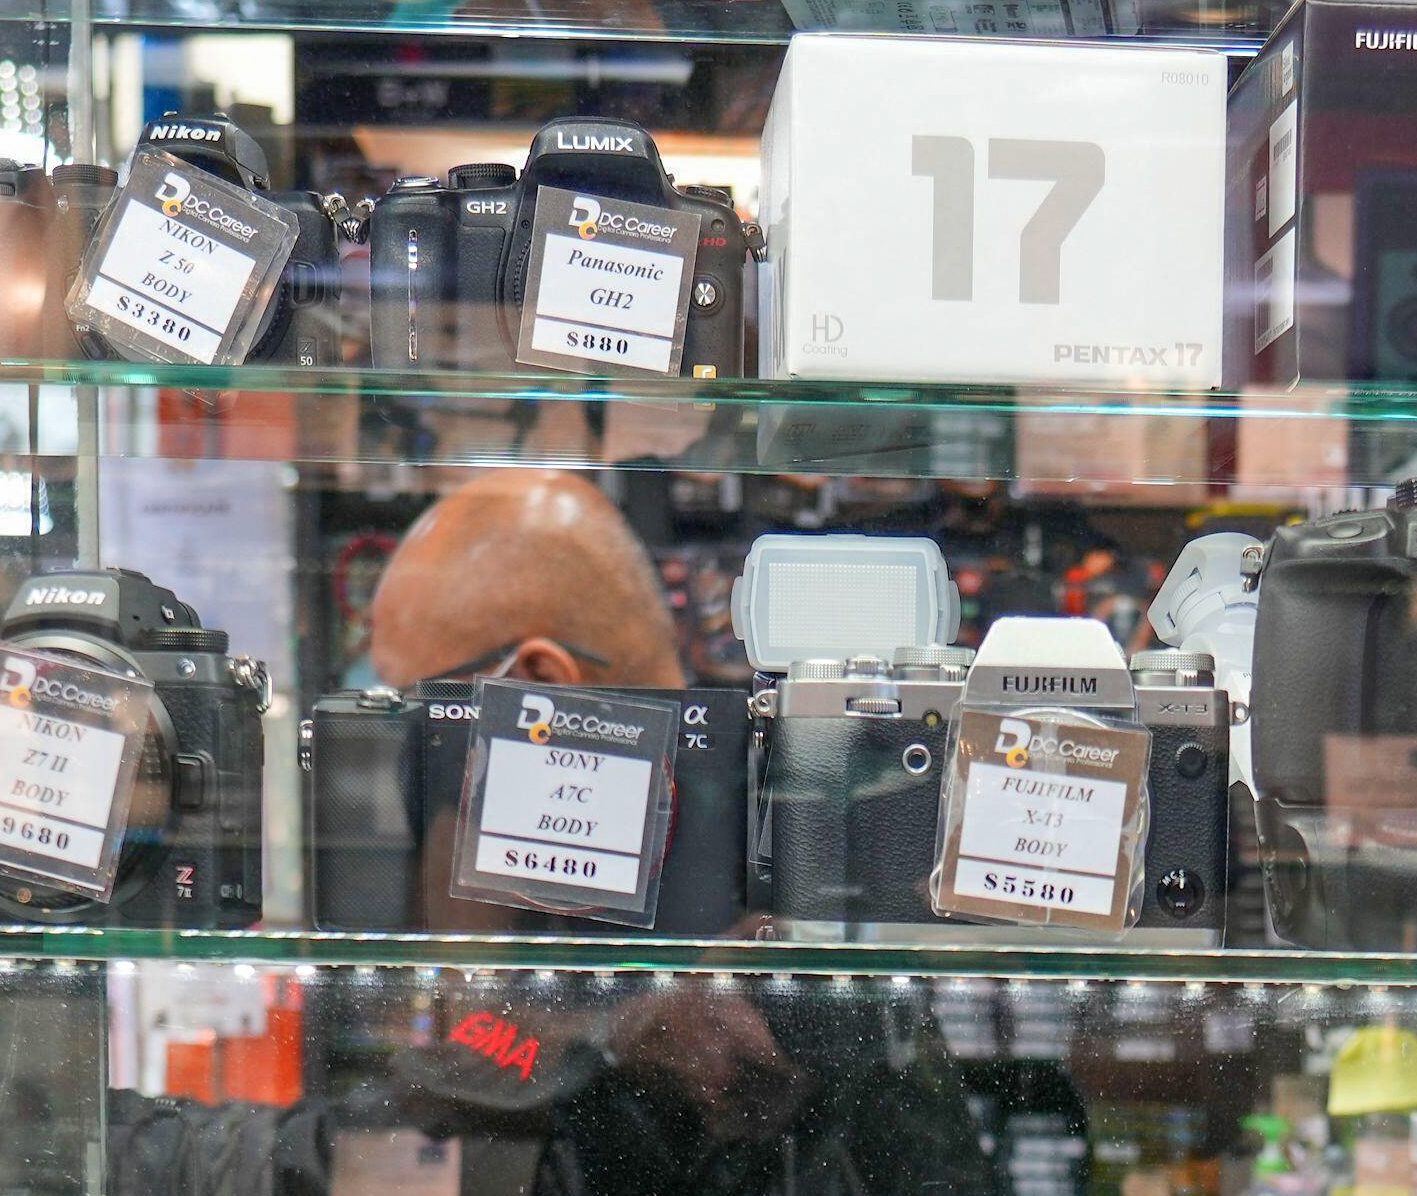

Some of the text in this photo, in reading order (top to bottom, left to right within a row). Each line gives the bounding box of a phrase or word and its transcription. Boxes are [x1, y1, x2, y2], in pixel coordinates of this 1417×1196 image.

[1161, 71, 1210, 86] R08010
[150, 125, 222, 142] Nikon
[557, 131, 634, 153] LUMIX
[466, 201, 507, 215] GH2
[911, 134, 1106, 305] 17
[159, 219, 219, 255] NIKON
[625, 215, 678, 238] Career
[566, 249, 665, 282] Panasonic
[140, 271, 192, 304] BODY
[589, 287, 635, 310] GH2
[811, 313, 845, 343] HD
[801, 341, 849, 358] Coating
[1053, 342, 1204, 367] PENTAX 17
[26, 588, 107, 606] Nikon
[1002, 674, 1098, 695] FUJIFILM
[1158, 702, 1208, 714] X-T3
[16, 713, 89, 743] NIKON
[685, 733, 708, 750] 7C
[545, 749, 606, 773] SONY
[11, 780, 70, 807] BODY
[549, 785, 593, 804] A7C
[1002, 776, 1096, 803] FUJIFILM
[537, 814, 599, 838] BODY
[1013, 836, 1069, 858] BODY
